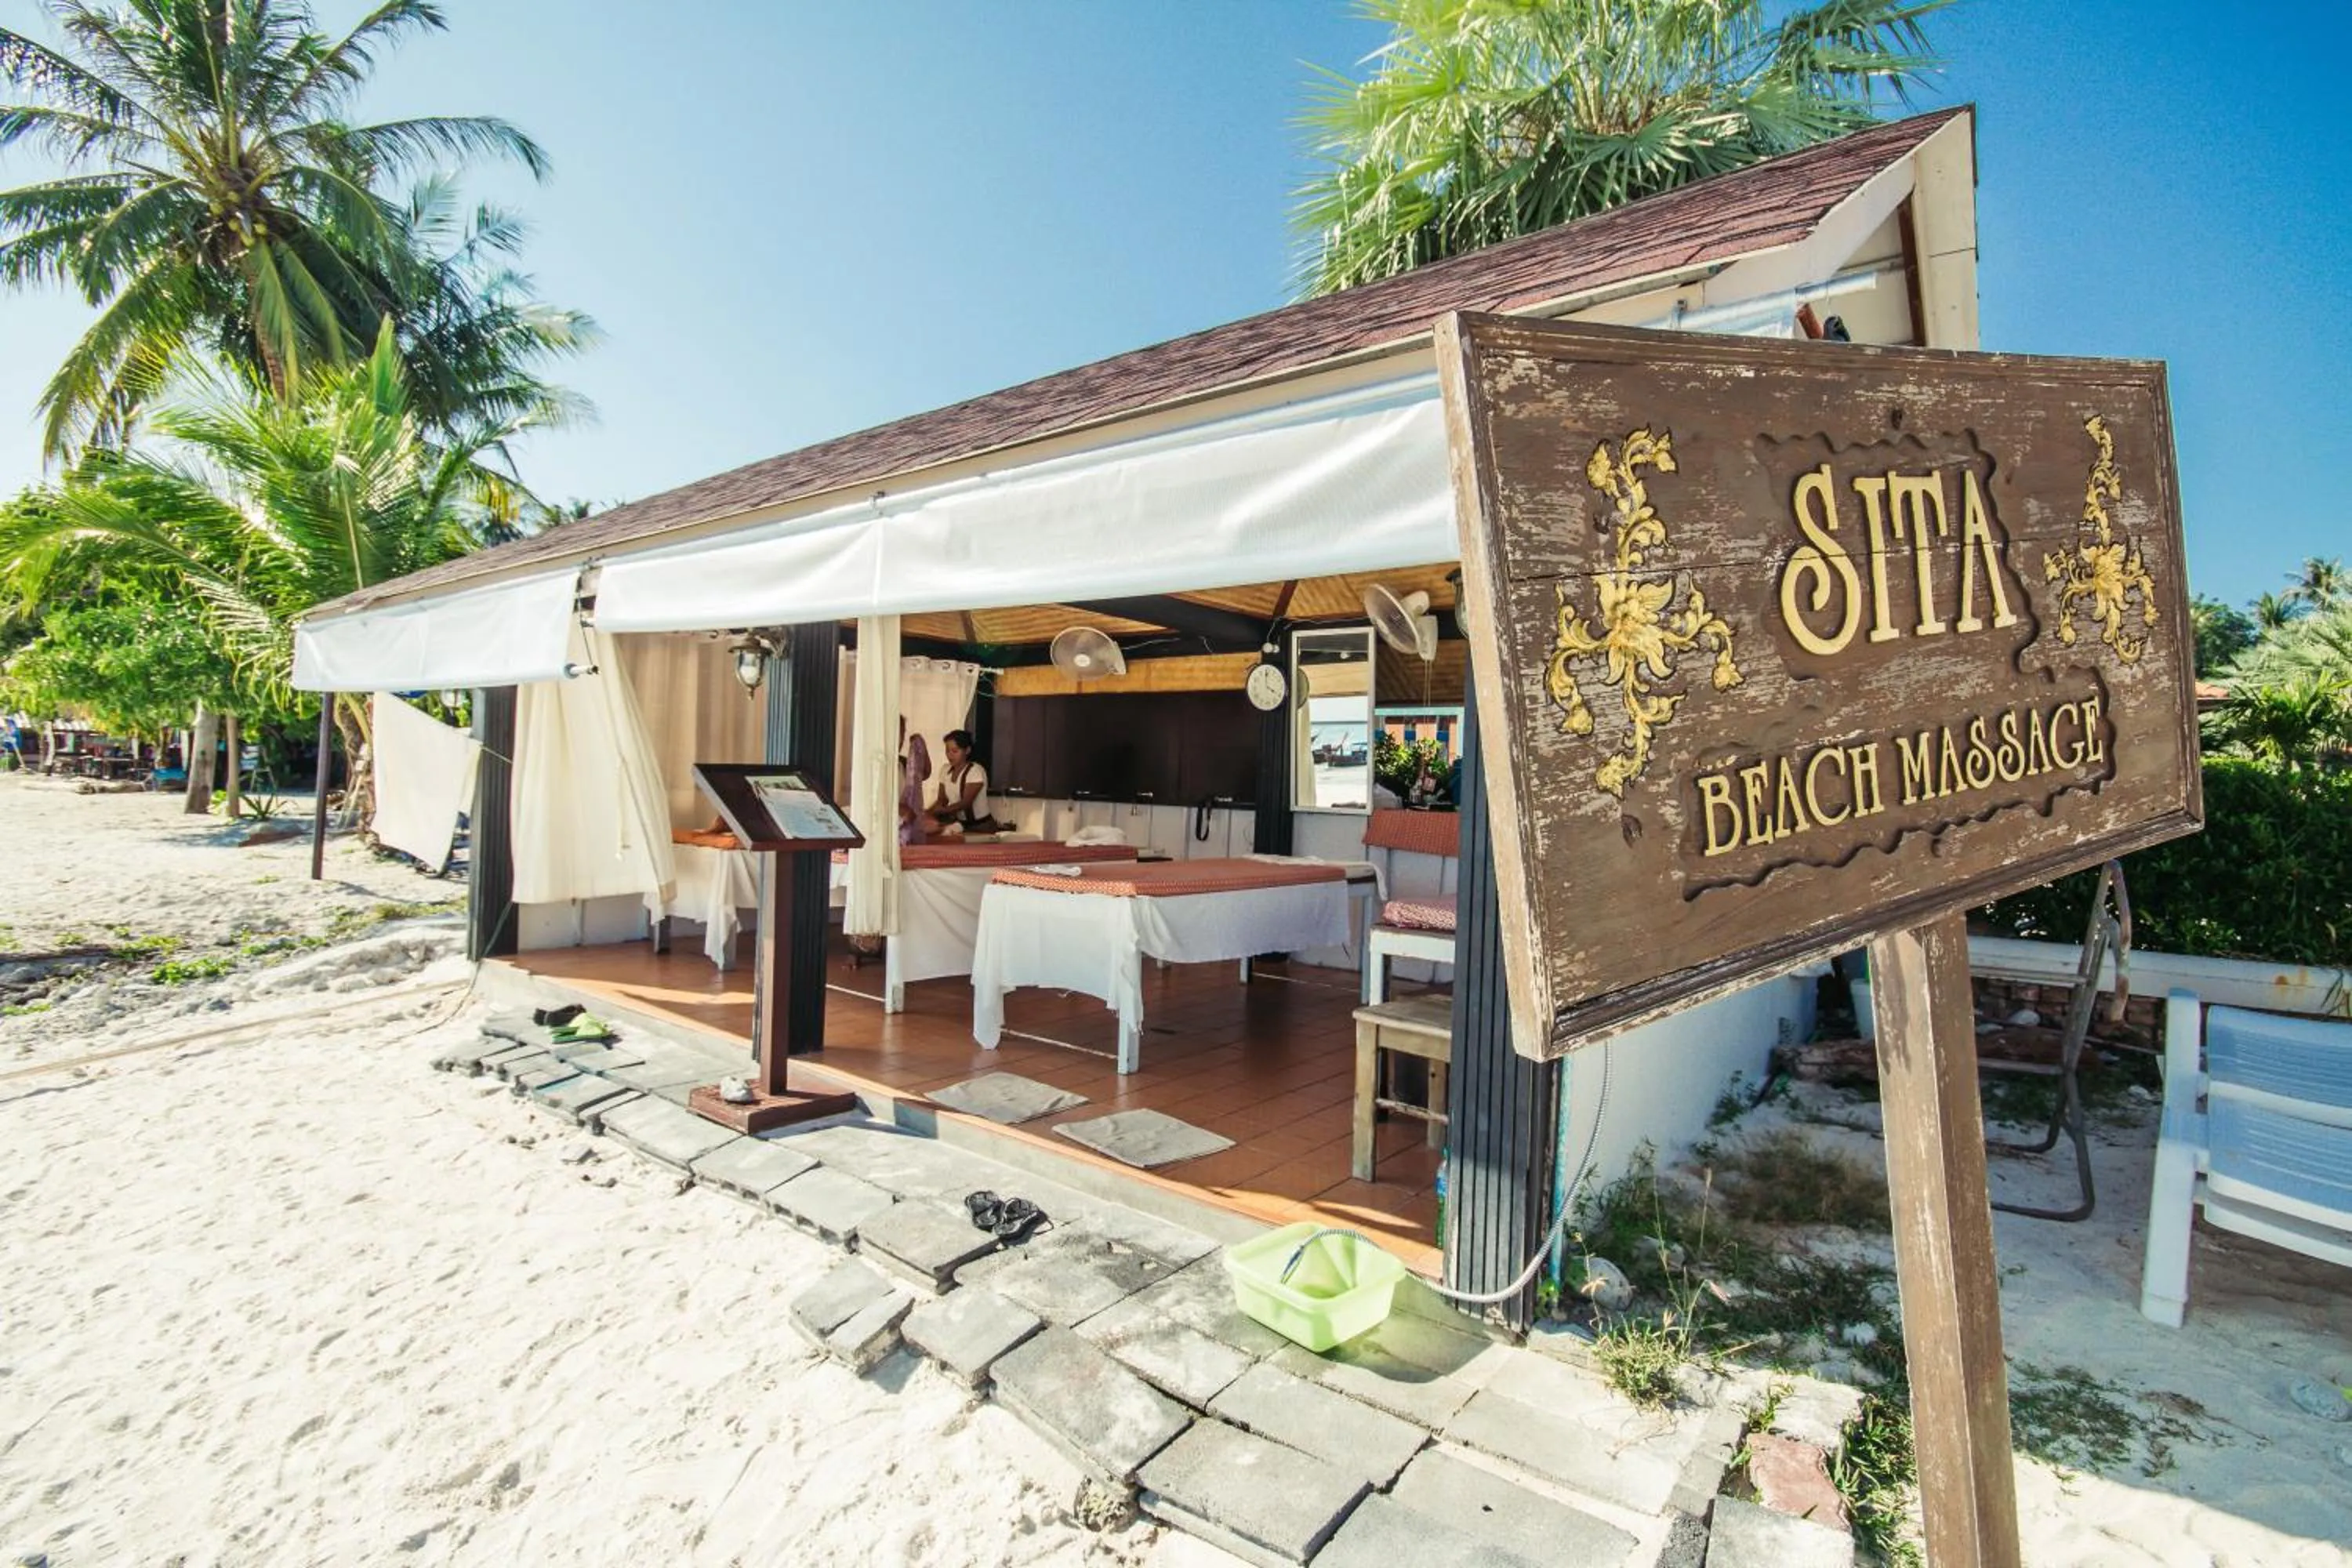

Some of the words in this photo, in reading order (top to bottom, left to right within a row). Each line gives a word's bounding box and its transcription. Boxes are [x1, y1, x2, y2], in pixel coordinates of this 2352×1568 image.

[1780, 463, 2017, 655] SITA
[1698, 742, 1885, 857] BEACH
[1896, 695, 2104, 807] MASSAGE
